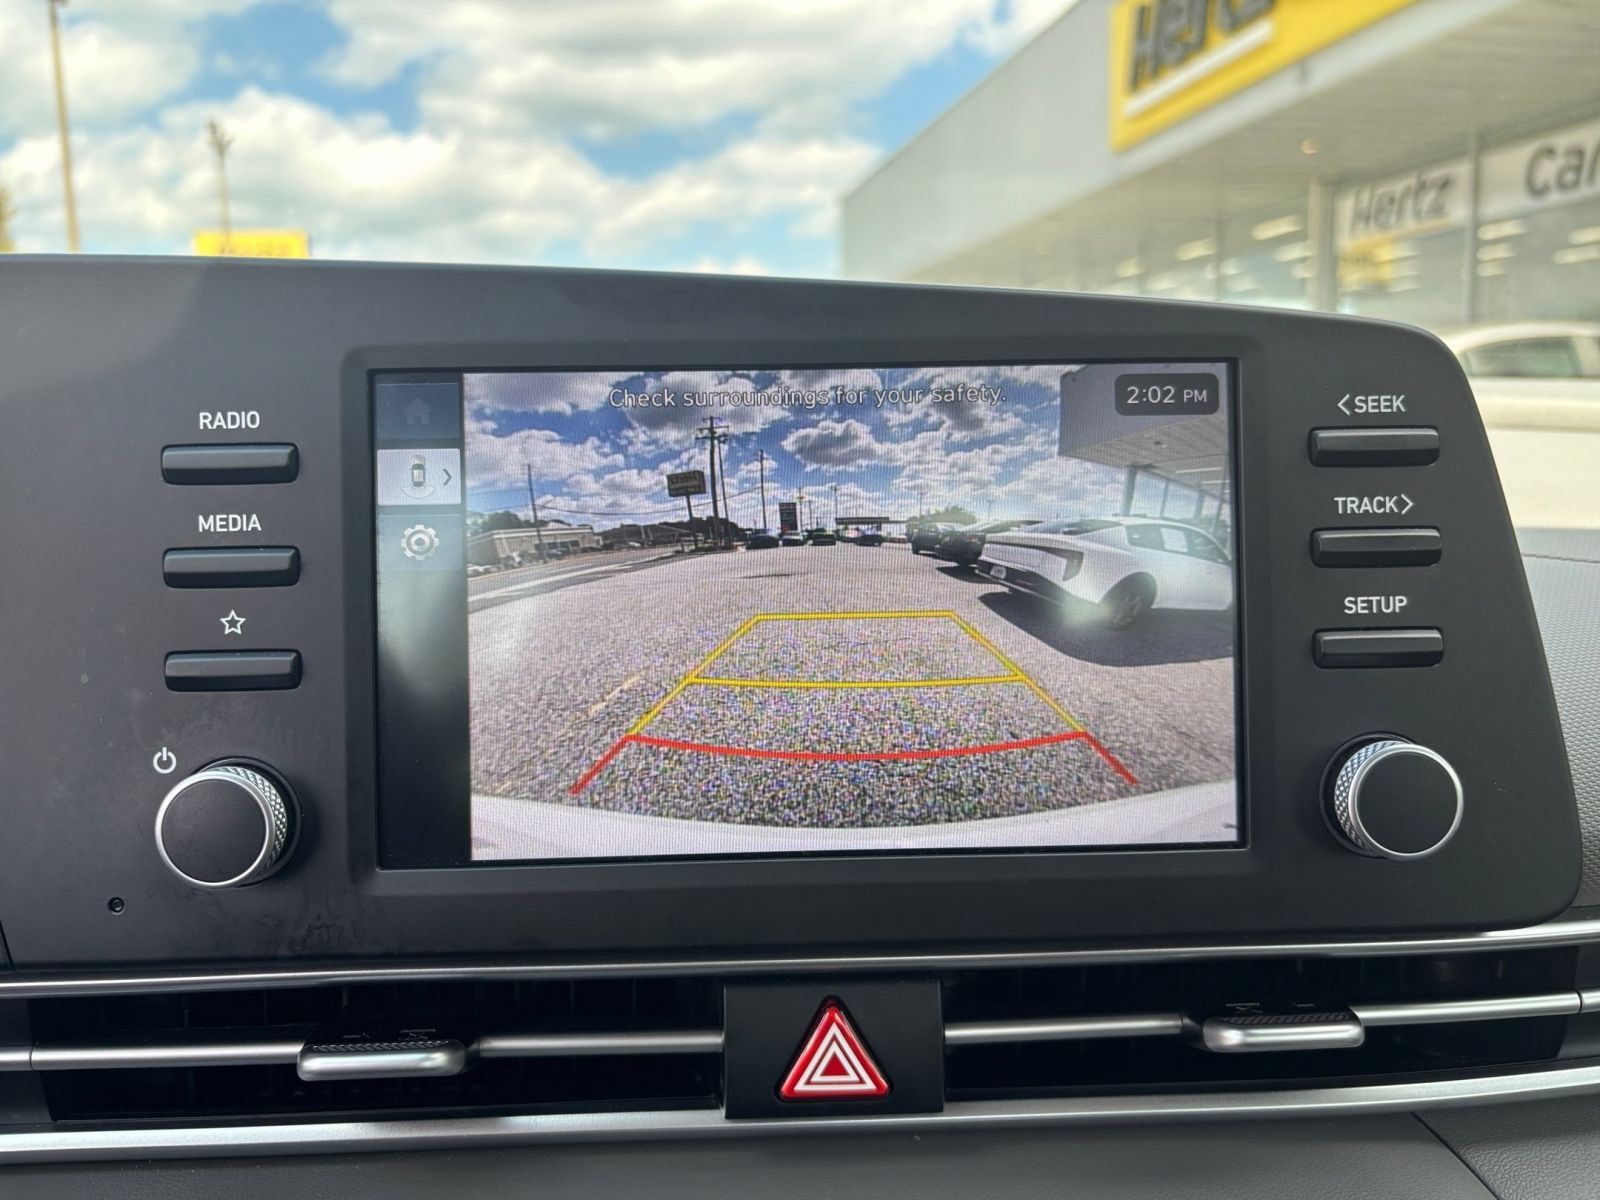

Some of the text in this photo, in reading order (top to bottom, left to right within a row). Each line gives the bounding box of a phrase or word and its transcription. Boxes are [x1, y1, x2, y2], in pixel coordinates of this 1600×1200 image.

[608, 384, 1007, 409] Check surroundings for your safety.
[1126, 385, 1208, 404] 2:02 PM
[198, 410, 261, 430] RADIO
[197, 513, 263, 533] MEDIA
[1343, 595, 1408, 615] SETUP
